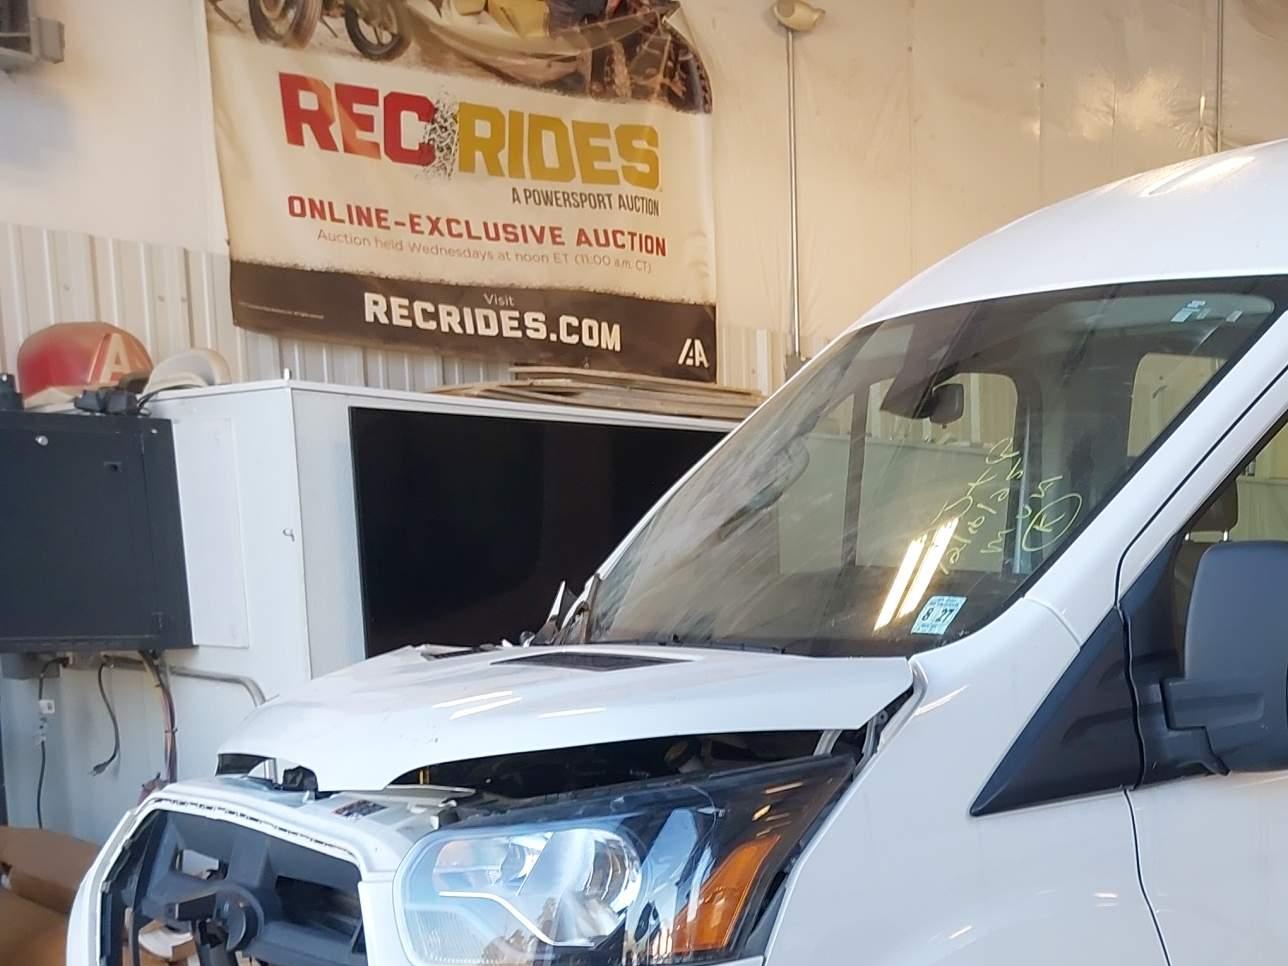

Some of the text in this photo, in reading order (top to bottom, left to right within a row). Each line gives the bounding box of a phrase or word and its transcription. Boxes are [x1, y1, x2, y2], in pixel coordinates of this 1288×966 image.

[278, 71, 660, 191] REC RIDES
[511, 186, 660, 217] A POWERSPORT AUCTION
[287, 195, 667, 257] ONLINE-EXCLUSIVE AUCTION
[317, 228, 372, 248] Auction
[374, 236, 404, 252] held
[407, 240, 494, 262] Wednesdays
[497, 252, 512, 263] at
[515, 252, 550, 265] noon
[553, 253, 569, 264] ET
[483, 293, 515, 307] Visit
[363, 292, 621, 353] RECRIDES.COM
[922, 607, 955, 623] 8 27
